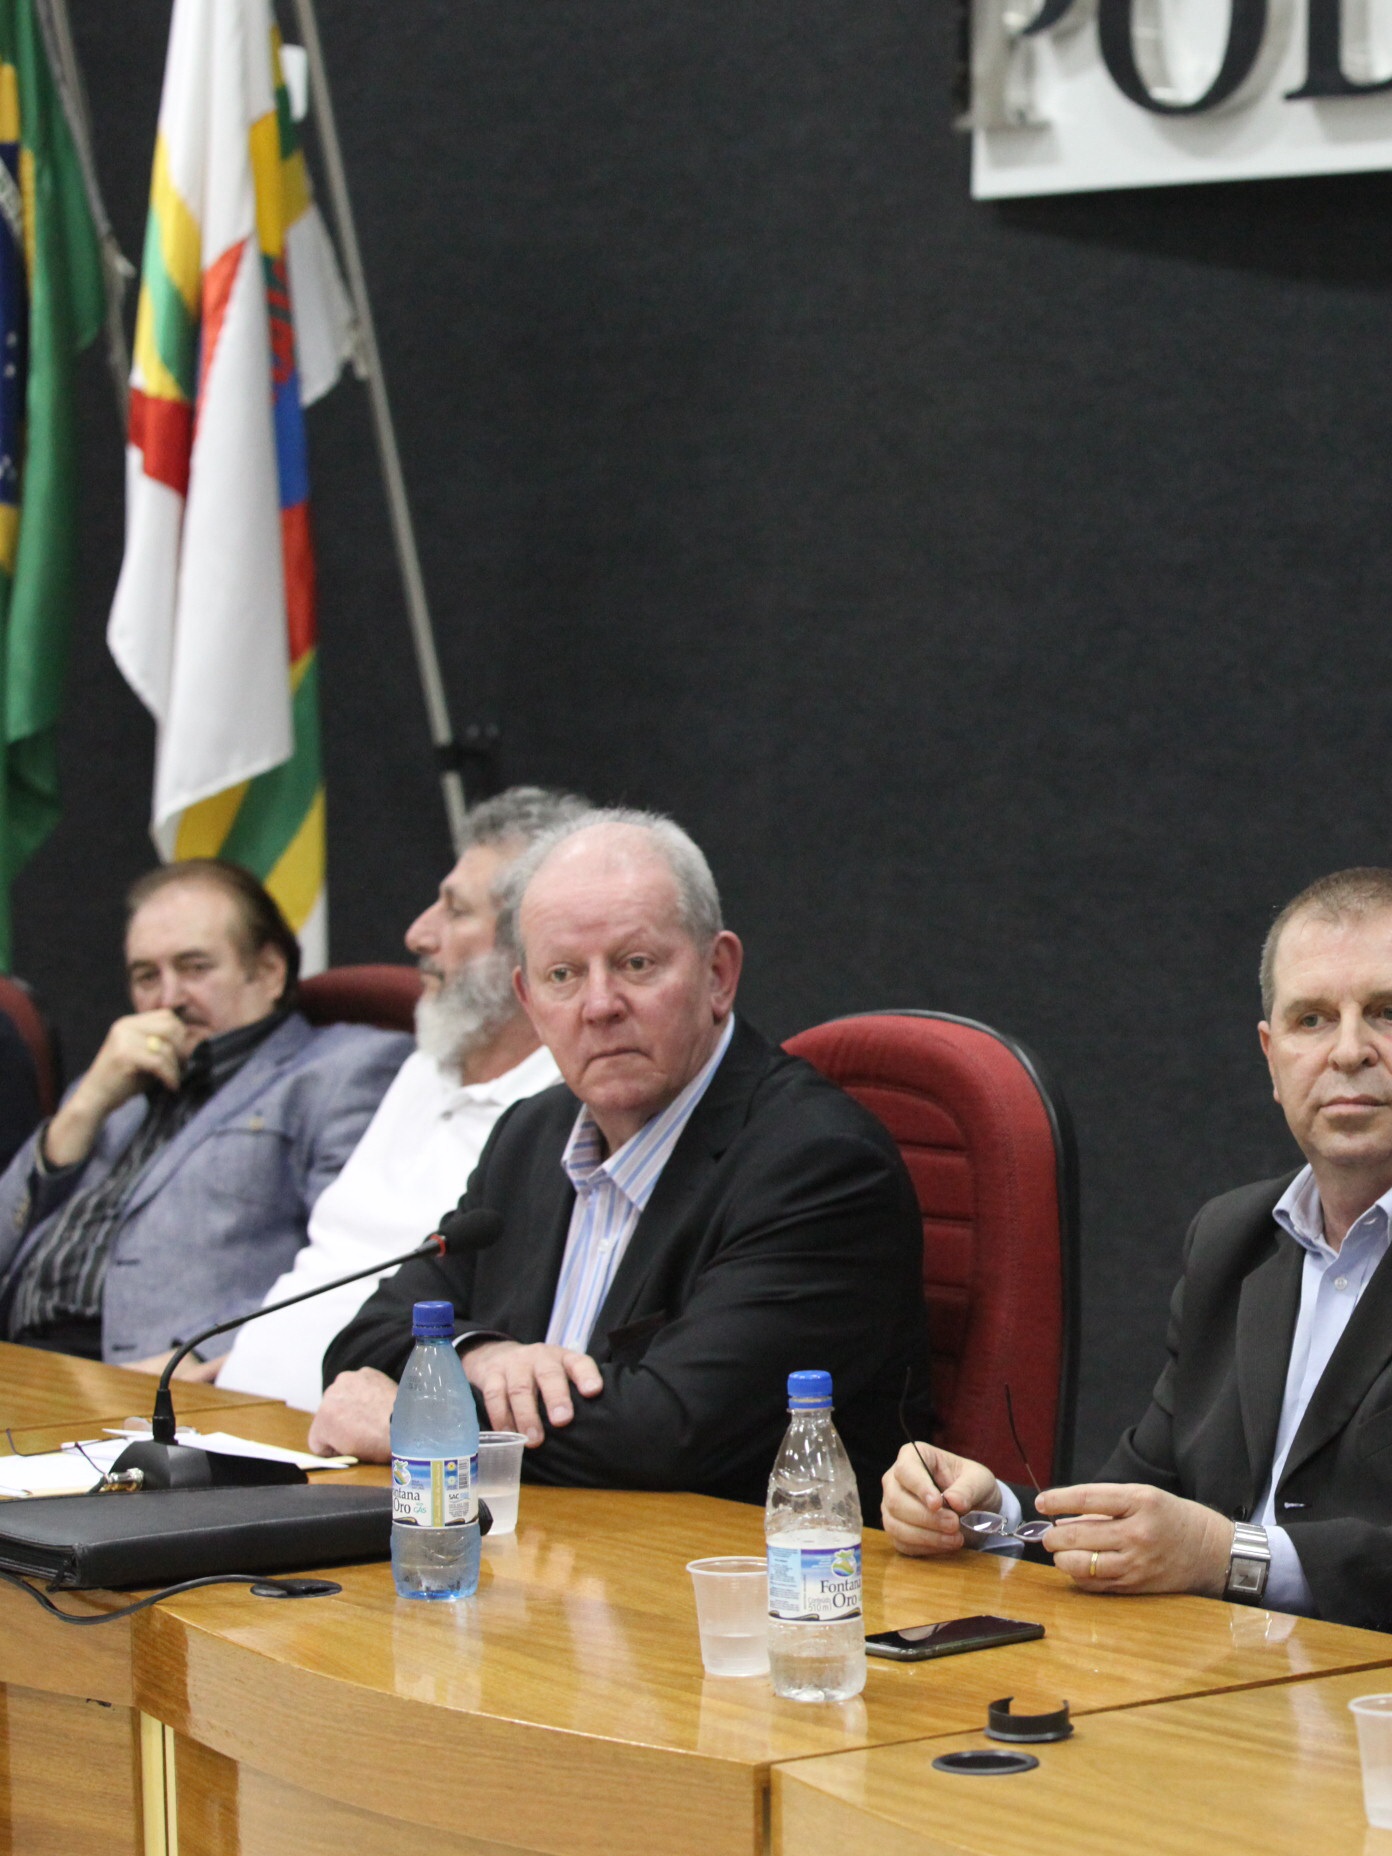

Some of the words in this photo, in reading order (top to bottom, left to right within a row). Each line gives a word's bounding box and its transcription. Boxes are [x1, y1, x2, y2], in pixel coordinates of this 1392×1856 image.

[392, 1488, 420, 1501] ntana
[393, 1497, 411, 1514] Oro
[832, 1592, 858, 1609] Oro
